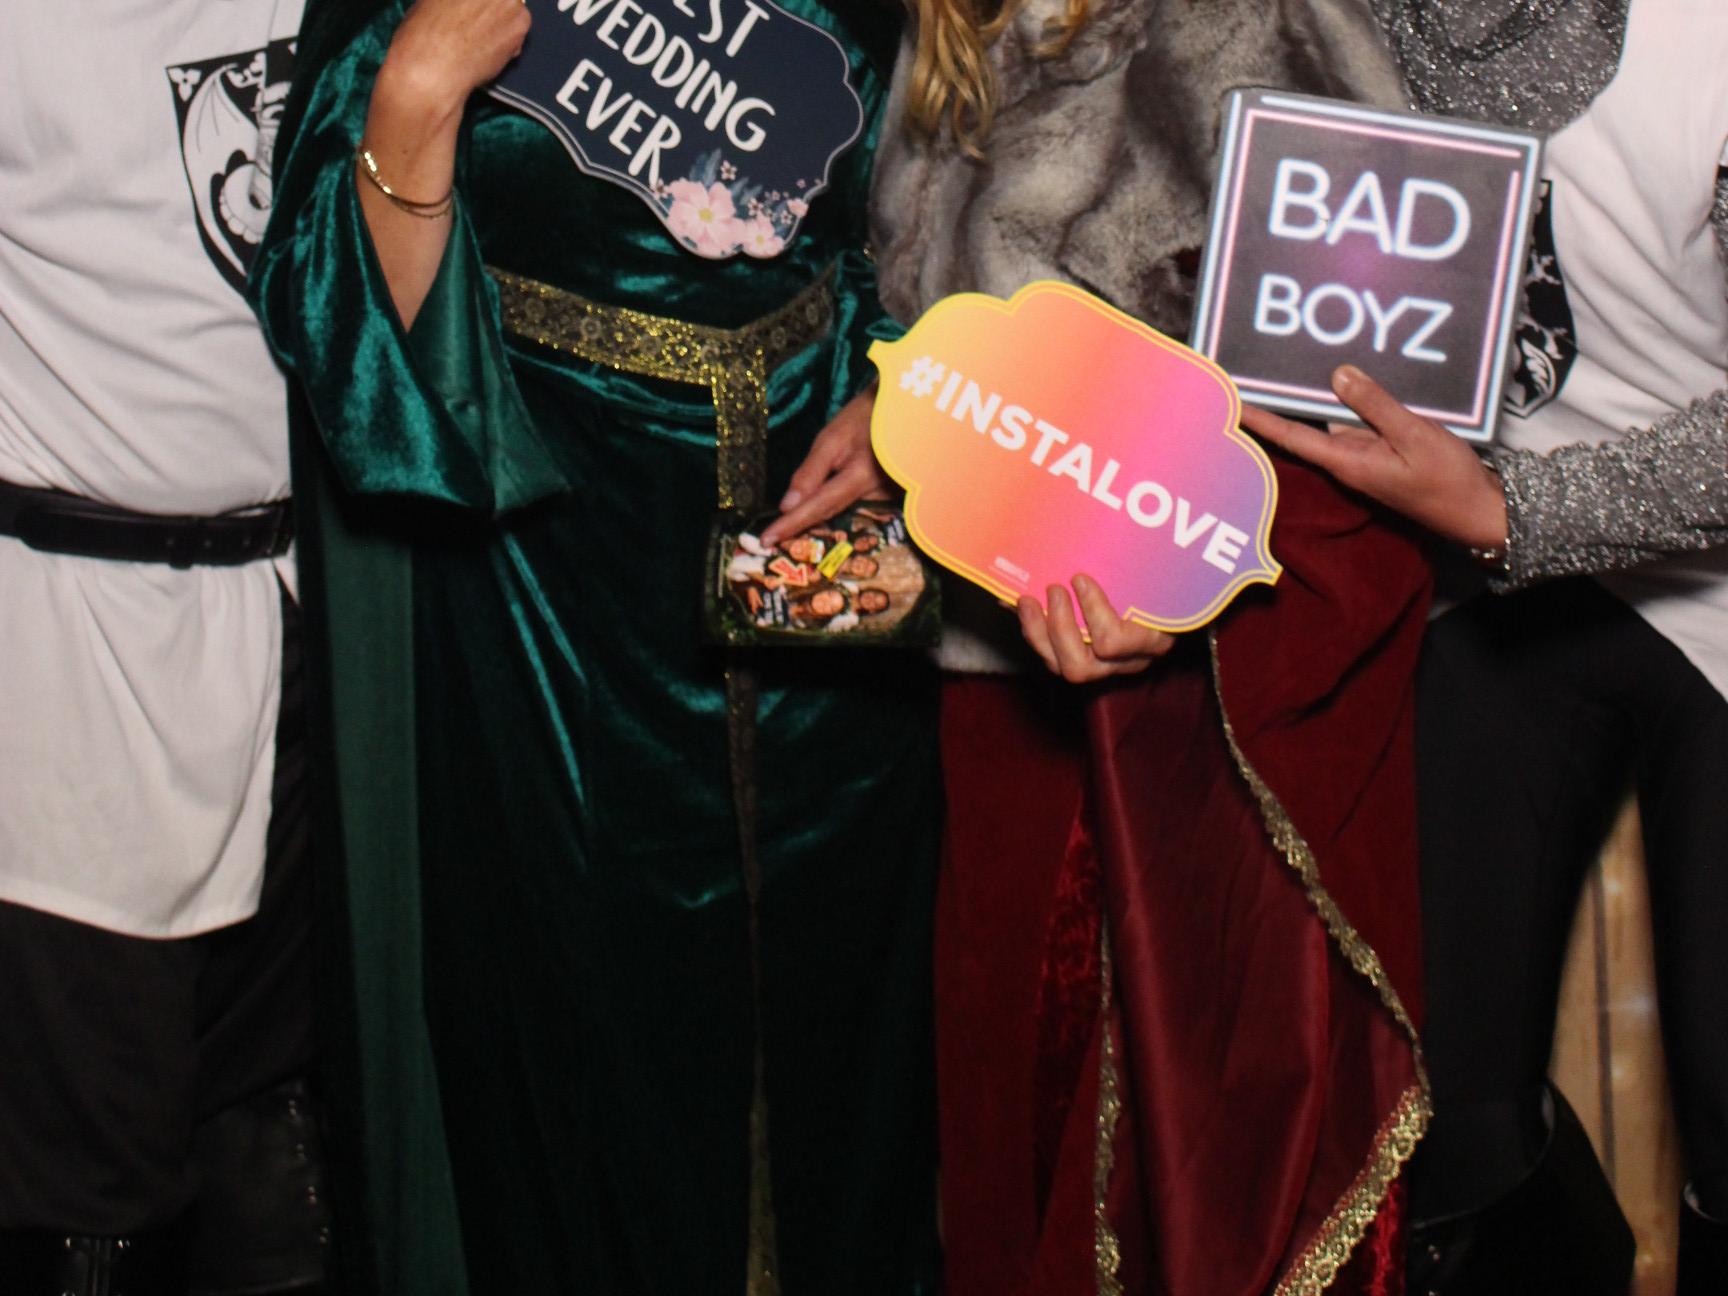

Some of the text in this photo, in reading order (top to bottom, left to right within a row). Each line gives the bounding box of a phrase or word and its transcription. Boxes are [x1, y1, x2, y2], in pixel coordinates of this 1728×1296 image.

[556, 59, 681, 191] EVER
[1269, 158, 1471, 261] BAD
[1254, 273, 1453, 363] BOYZ
[899, 355, 1249, 574] #INSTALOVE
